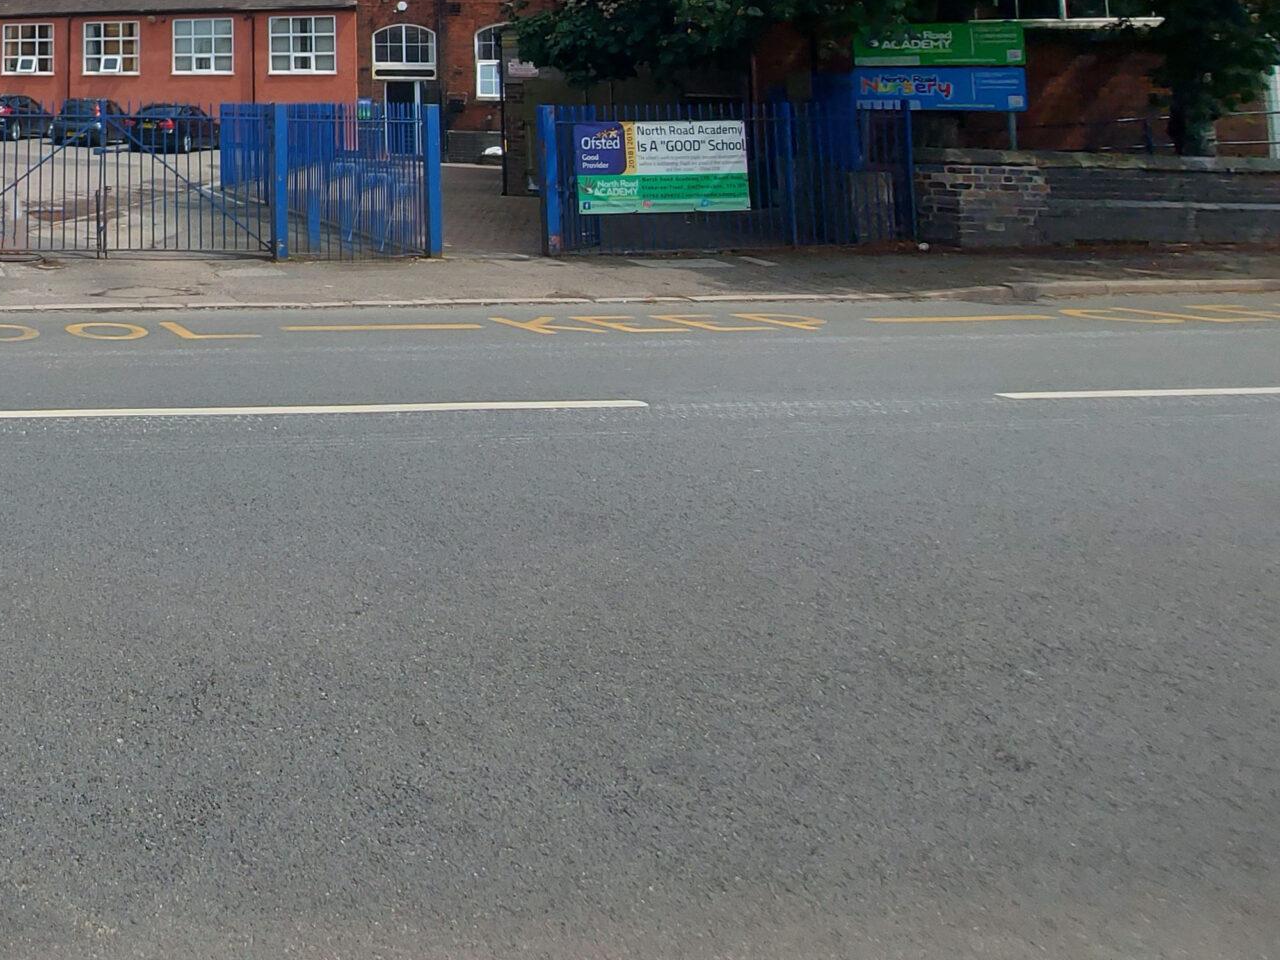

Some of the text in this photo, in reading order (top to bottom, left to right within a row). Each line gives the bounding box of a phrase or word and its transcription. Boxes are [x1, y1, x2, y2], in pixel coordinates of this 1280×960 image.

[860, 76, 952, 99] Nursery
[636, 125, 743, 136] North Road Academy
[581, 136, 620, 150] Ofsted
[636, 138, 747, 152] Is A "GOOD" School
[581, 153, 599, 161] Good
[597, 179, 639, 188] North Road
[594, 187, 639, 196] ACADEMY
[487, 313, 827, 334] KEEP
